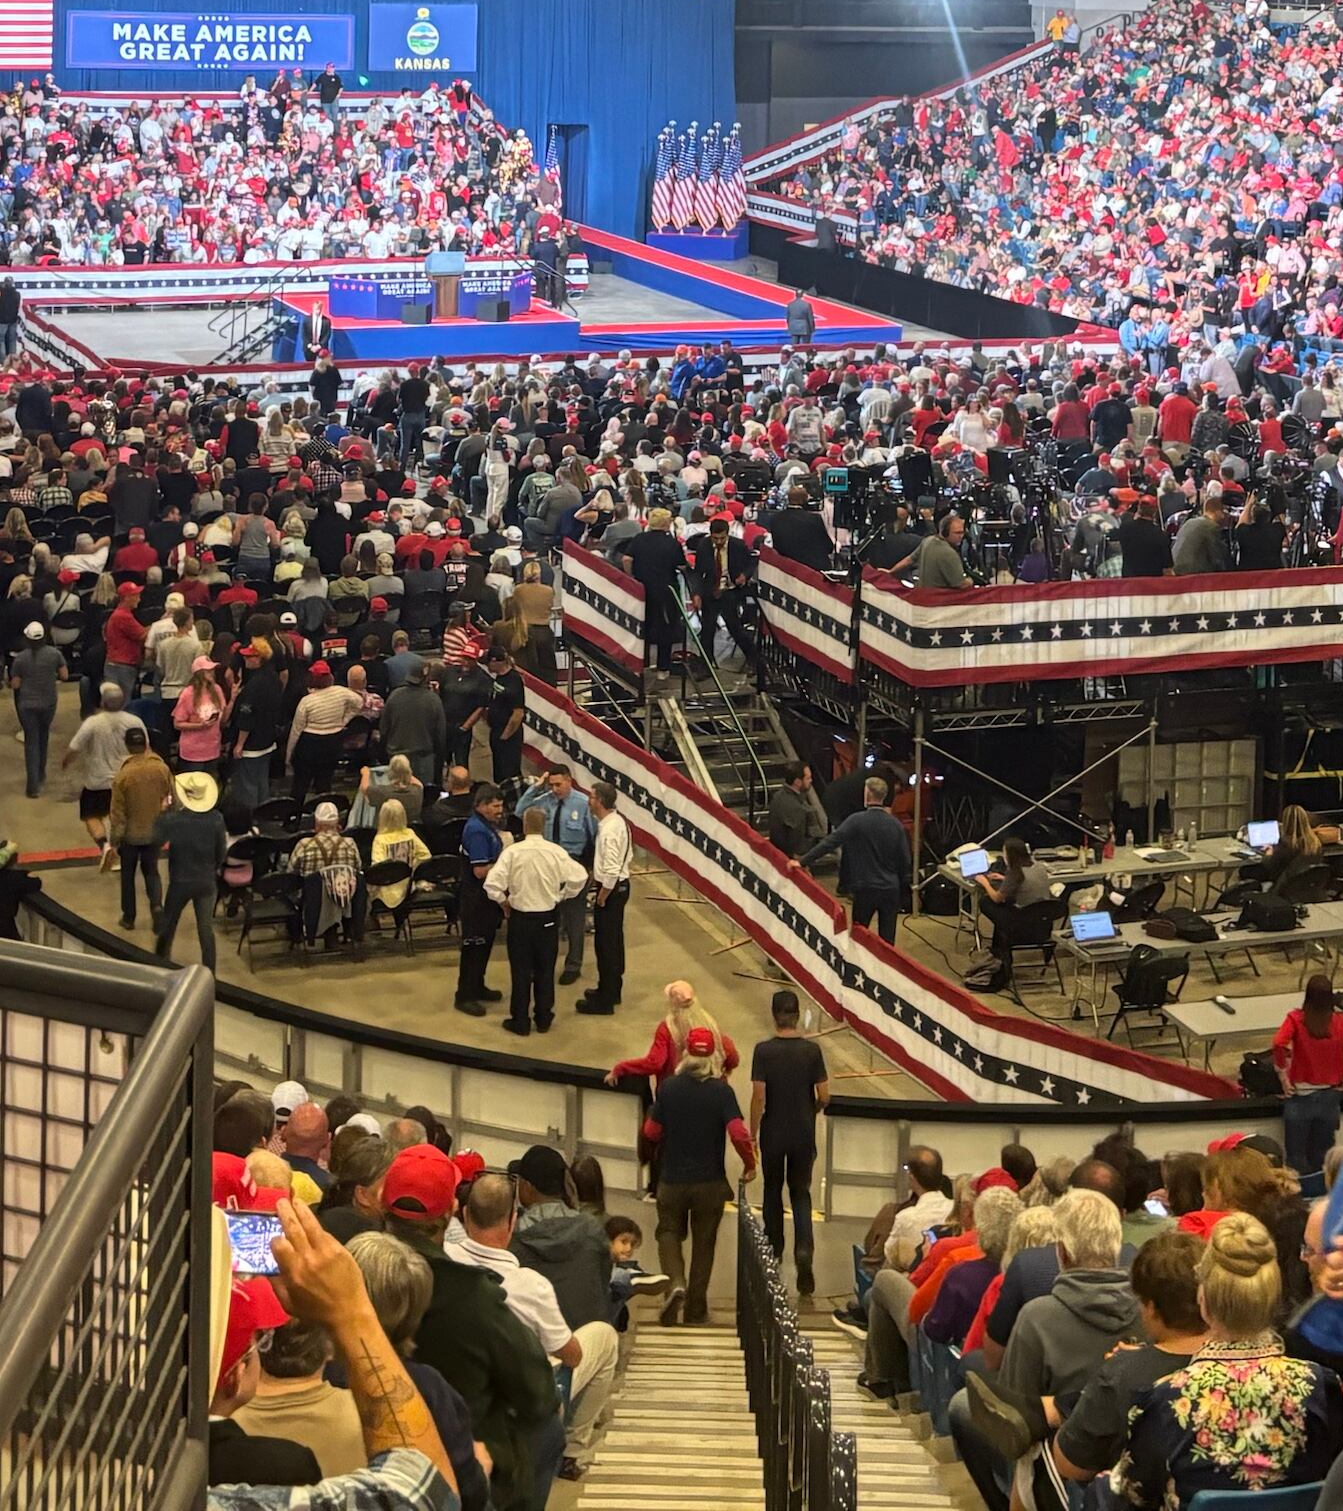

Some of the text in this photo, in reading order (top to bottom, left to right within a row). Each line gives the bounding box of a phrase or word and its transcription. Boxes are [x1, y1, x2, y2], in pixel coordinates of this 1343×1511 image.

[113, 23, 312, 43] MAKE AMERICA
[119, 42, 305, 61] GREAT AGAIN!
[395, 57, 451, 70] KANSAS
